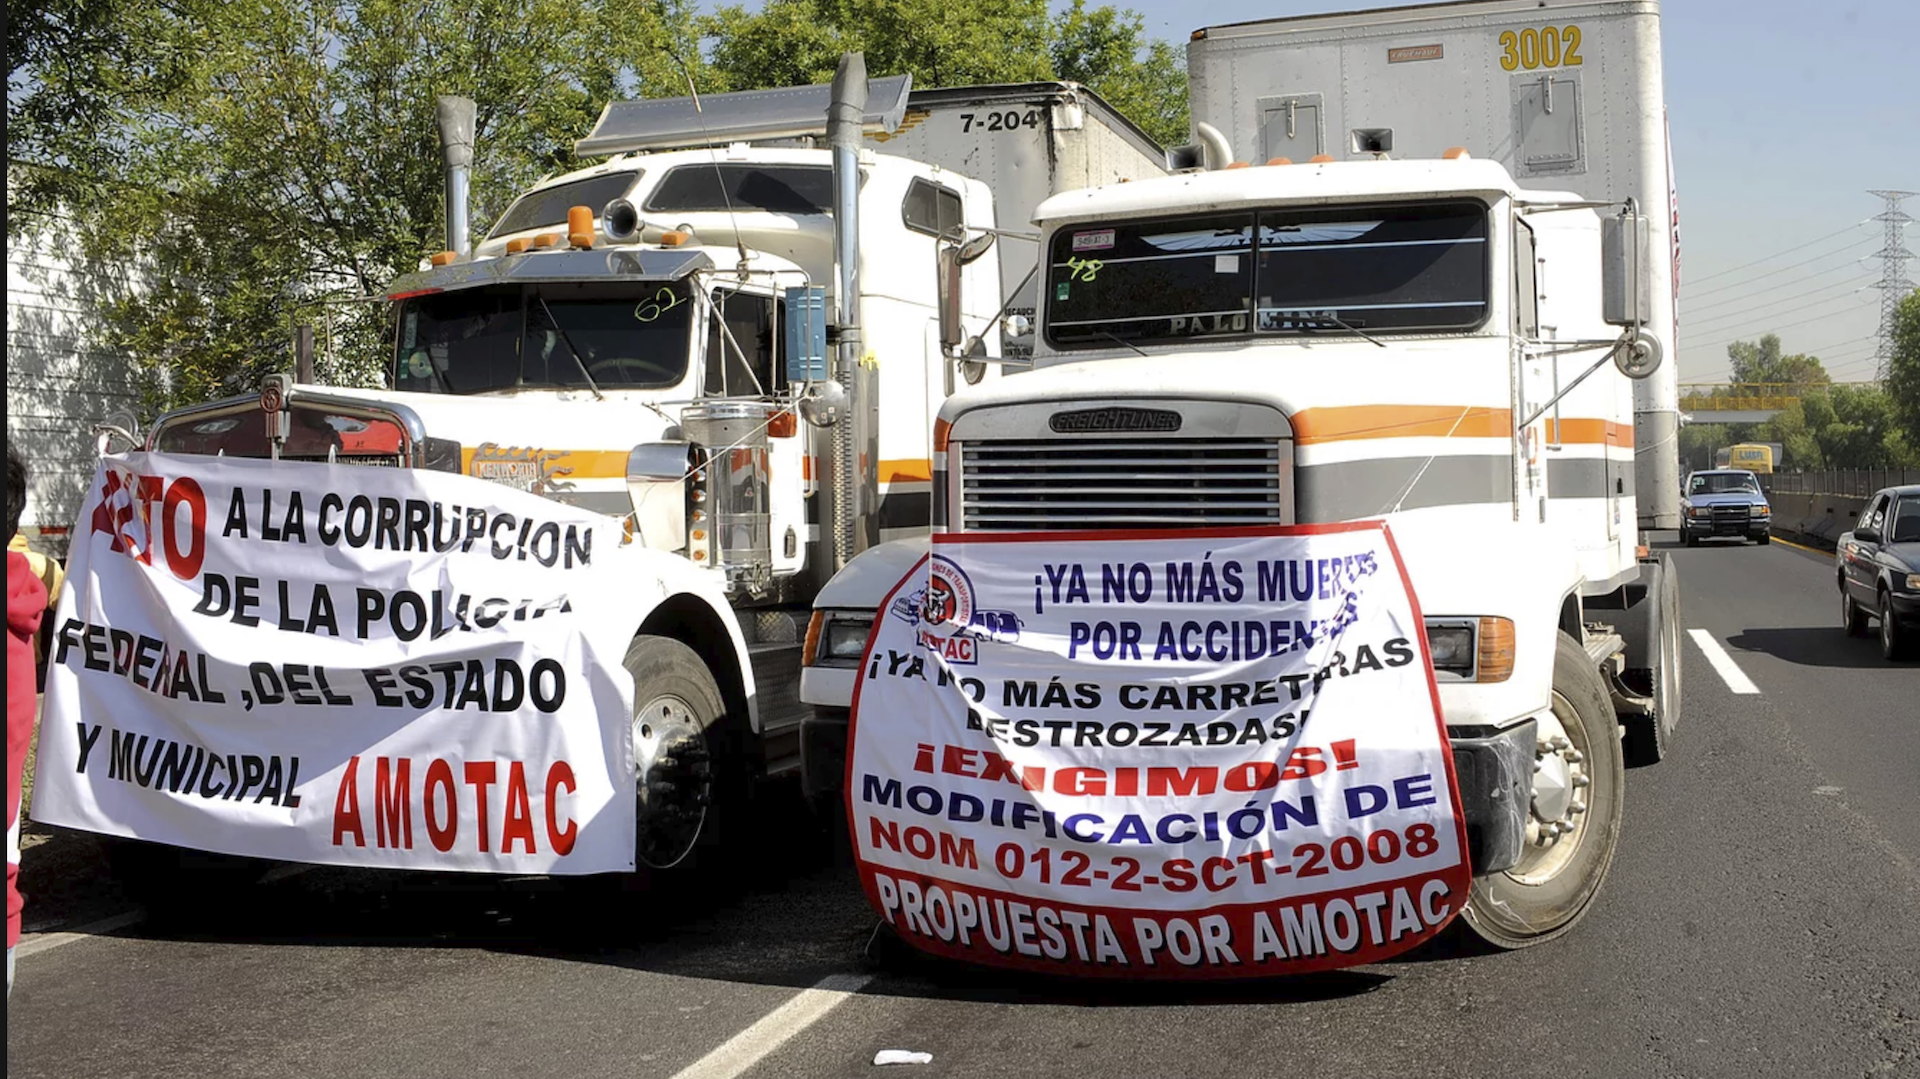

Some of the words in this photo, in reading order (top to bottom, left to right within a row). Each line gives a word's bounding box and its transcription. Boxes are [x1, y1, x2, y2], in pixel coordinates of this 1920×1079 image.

[1499, 25, 1582, 70] 3002
[960, 110, 1037, 133] 7-204
[1056, 409, 1178, 429] FREIGHTLINER
[222, 486, 248, 538] A
[261, 488, 307, 544] LA
[317, 493, 593, 570] CORRUPCION
[192, 572, 260, 627] DE
[277, 580, 339, 637] LA
[1034, 563, 1090, 614] ¡YA
[1102, 562, 1153, 603] NO
[1165, 550, 1244, 603] MÁS
[54, 617, 226, 704] FEDERAL
[361, 658, 566, 714] ESTADO
[1068, 620, 1142, 660] POR
[1003, 675, 1102, 709] MÁS
[76, 722, 102, 774] Y
[107, 729, 301, 808] MUNICIPAL
[332, 755, 578, 857] AMOTAC
[913, 737, 1360, 797] ¡EXIGIMOS!
[862, 774, 1319, 845] MODIFICACIÓN
[1343, 773, 1437, 819] DE
[869, 815, 979, 870] NOM
[994, 822, 1440, 895] 012-2-SCT-2008
[875, 872, 1128, 966] PROPUESTA
[1132, 913, 1240, 966] POR
[1252, 878, 1450, 962] AMOTAC
